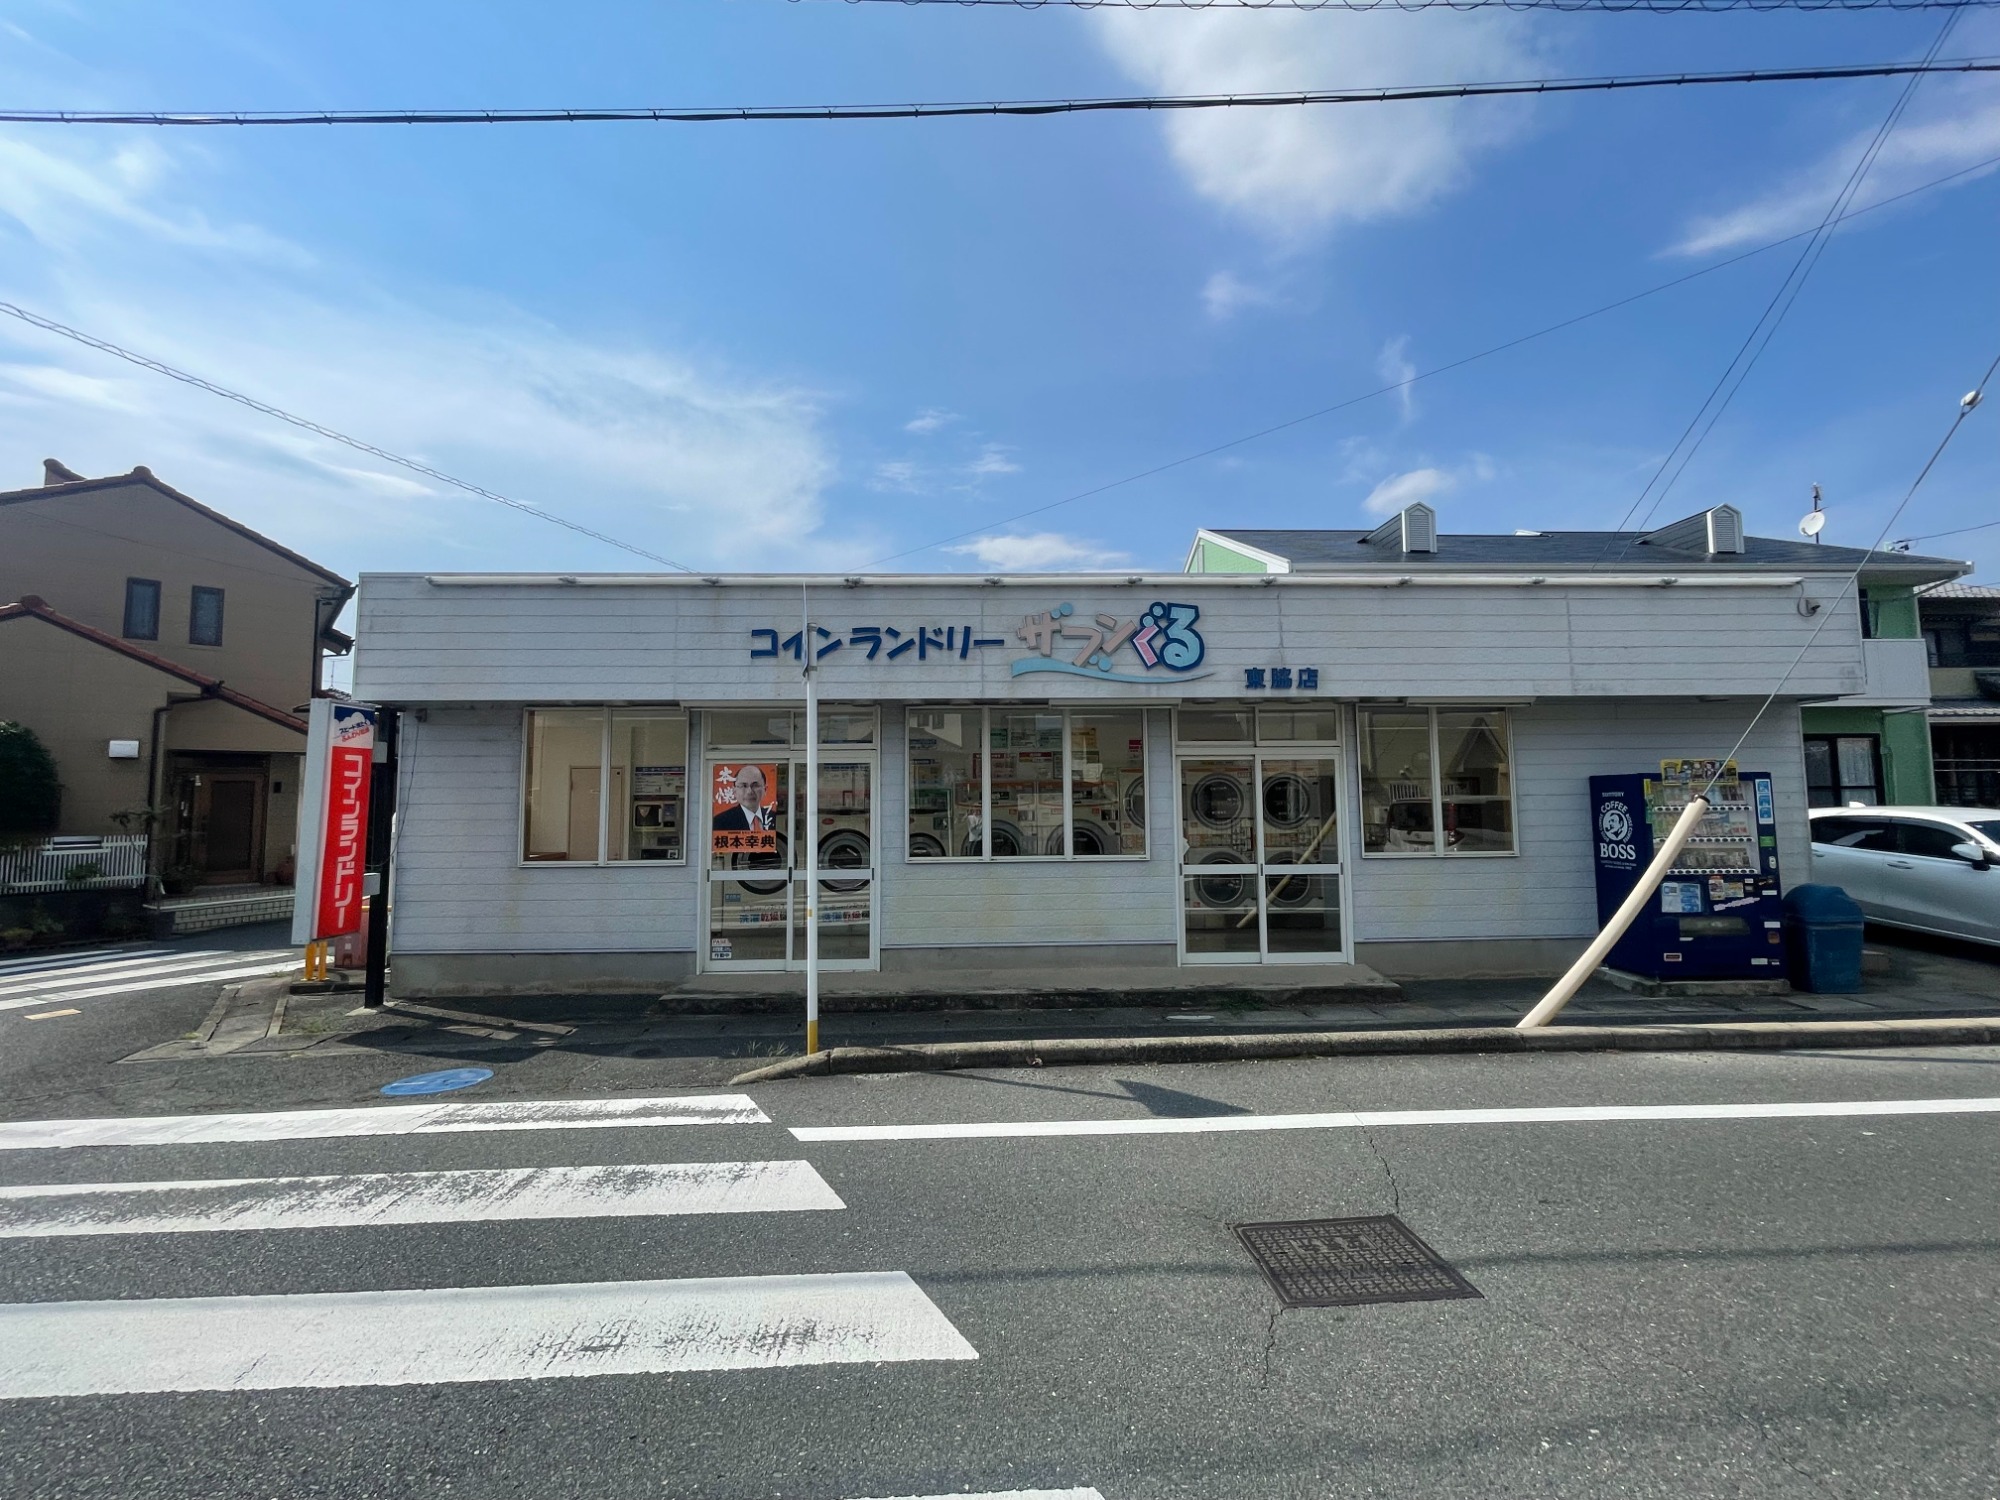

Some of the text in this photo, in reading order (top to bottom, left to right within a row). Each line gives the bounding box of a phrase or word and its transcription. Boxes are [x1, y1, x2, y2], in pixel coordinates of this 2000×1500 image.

[750, 626, 1004, 661] コインランドリー
[1015, 601, 1205, 672] ザブンぐる
[1244, 667, 1319, 689] 東脇店
[1600, 800, 1628, 814] COFFEE
[334, 755, 363, 928] コインランドリー
[714, 835, 775, 849] 根本幸典
[1600, 842, 1637, 860] BOSS
